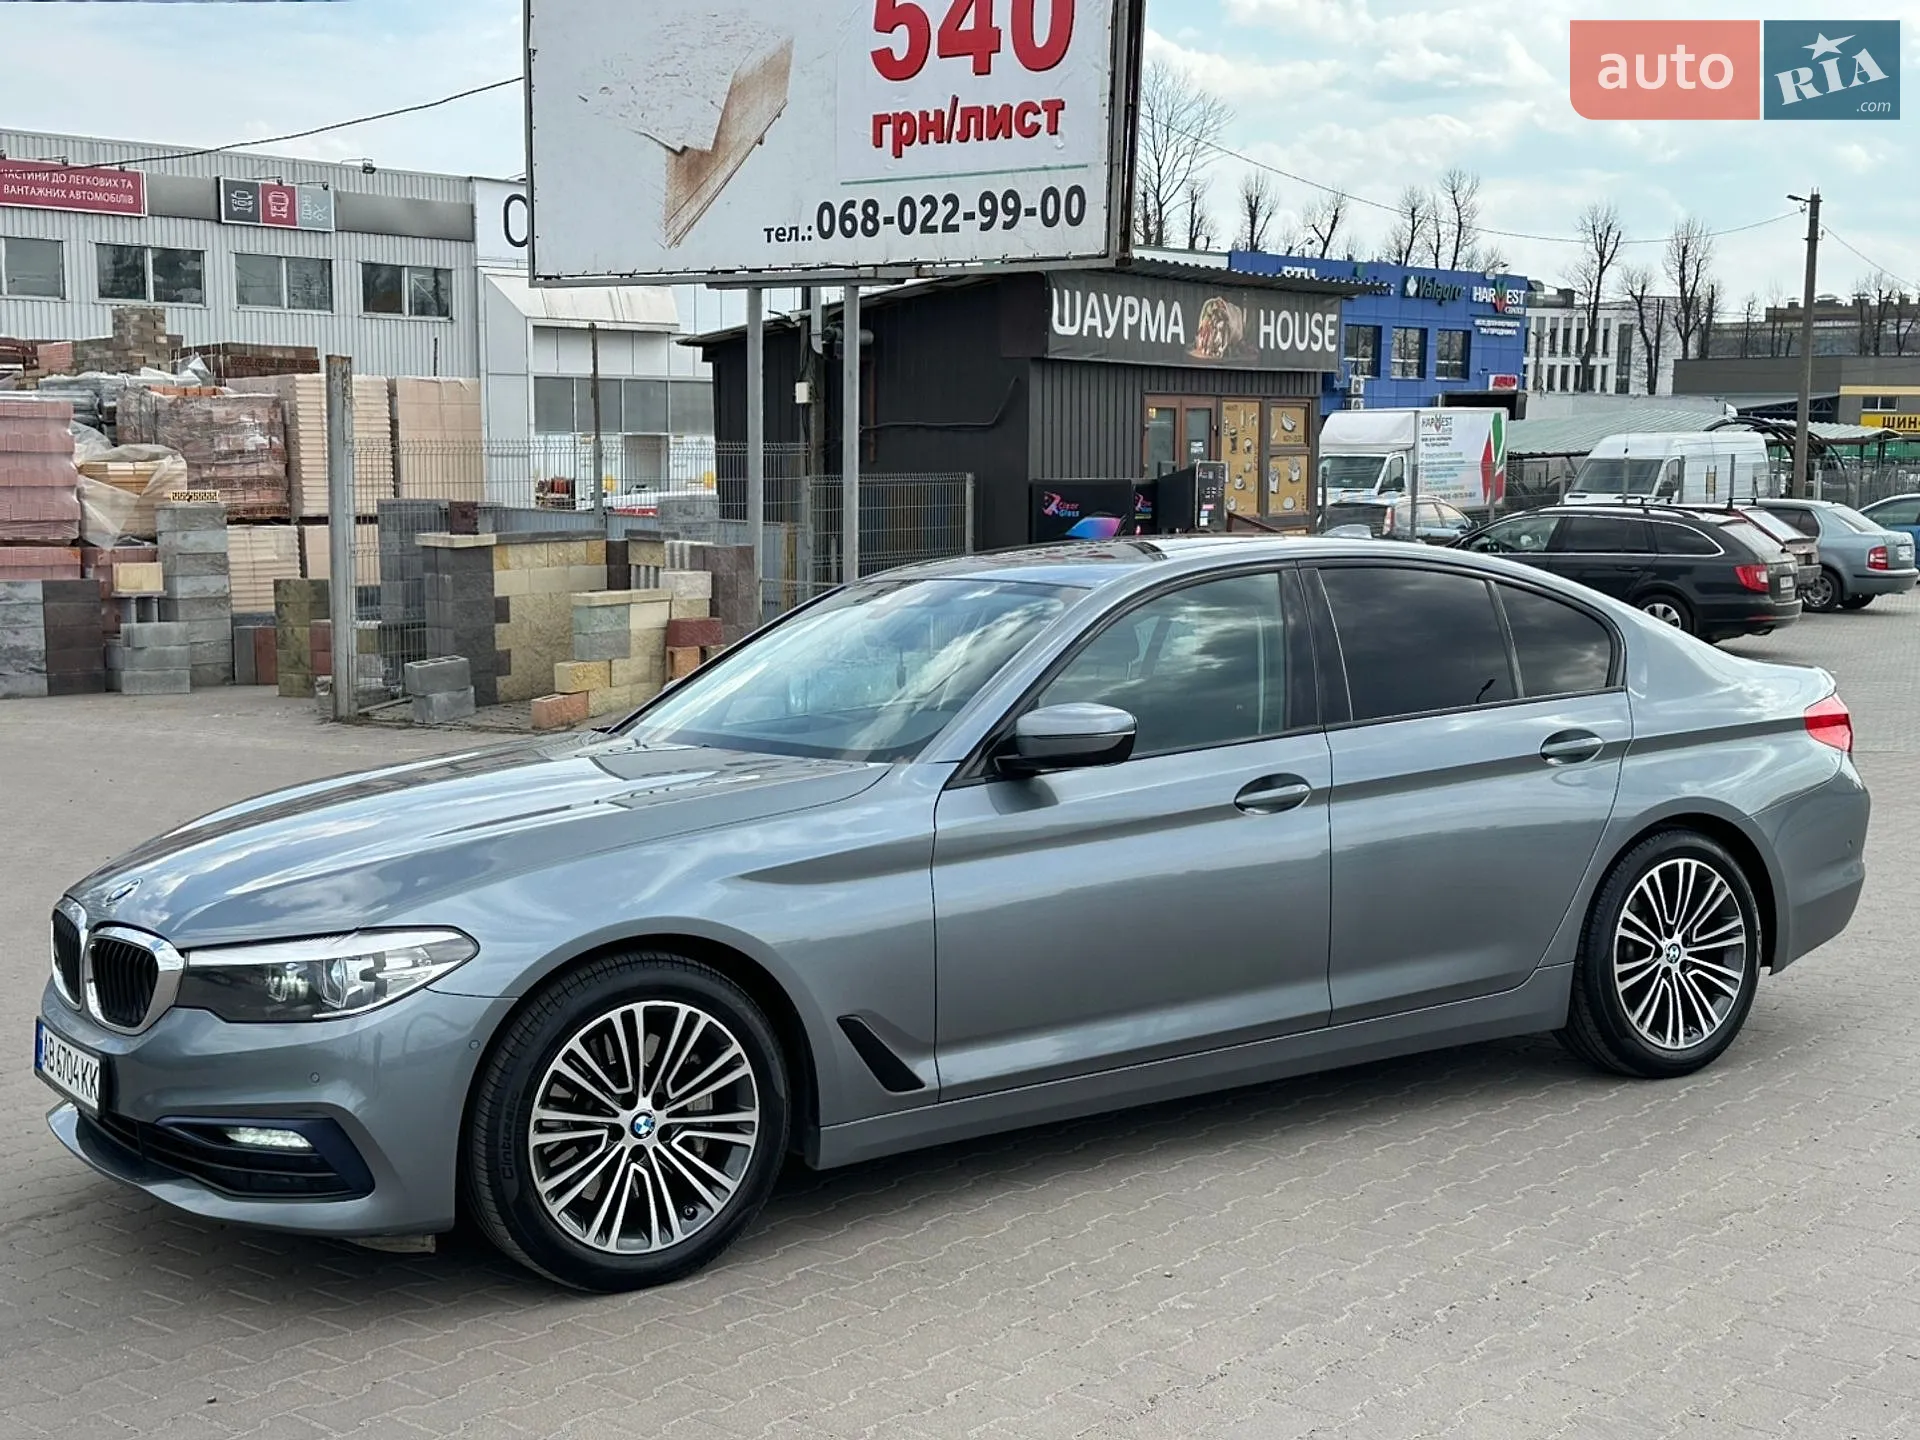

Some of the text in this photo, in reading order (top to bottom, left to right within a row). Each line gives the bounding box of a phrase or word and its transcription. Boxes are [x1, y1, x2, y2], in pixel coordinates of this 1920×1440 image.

[870, 0, 1075, 81] 540
[872, 94, 1066, 159] грн/лист
[4, 184, 134, 205] ВАНТАЖНИХ АВТОМОБІЛІВ
[51, 173, 67, 184] ДО
[69, 174, 118, 189] ЛЕГКОВИХ
[121, 178, 133, 189] ТА
[816, 184, 1086, 240] 068-022-99-00
[1052, 287, 1185, 345] ШАУРМА
[1258, 308, 1338, 353] HOUSE
[1882, 415, 1920, 429] ШИН
